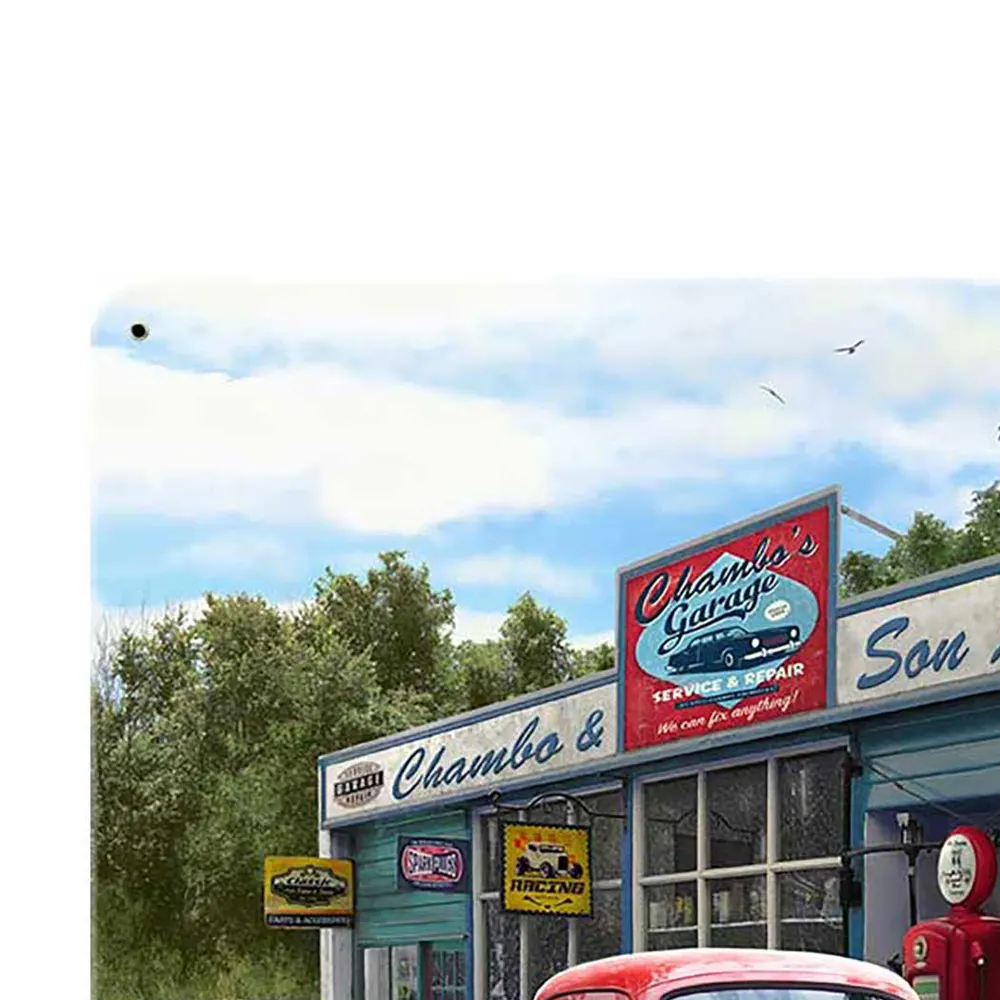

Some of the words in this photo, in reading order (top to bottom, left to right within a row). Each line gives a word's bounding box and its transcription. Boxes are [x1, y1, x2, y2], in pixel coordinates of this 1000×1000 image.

[634, 525, 819, 626] Chambo's
[657, 573, 780, 656] Garage
[651, 678, 722, 704] SERVICE
[726, 675, 739, 689] &
[744, 662, 805, 686] REPAIR
[856, 617, 970, 690] Son
[656, 721, 678, 735] We
[680, 716, 707, 730] can
[707, 709, 728, 729] fix
[730, 688, 800, 721] anything!
[391, 716, 565, 800] Chambo
[575, 709, 605, 752] &
[509, 879, 586, 896] RACING
